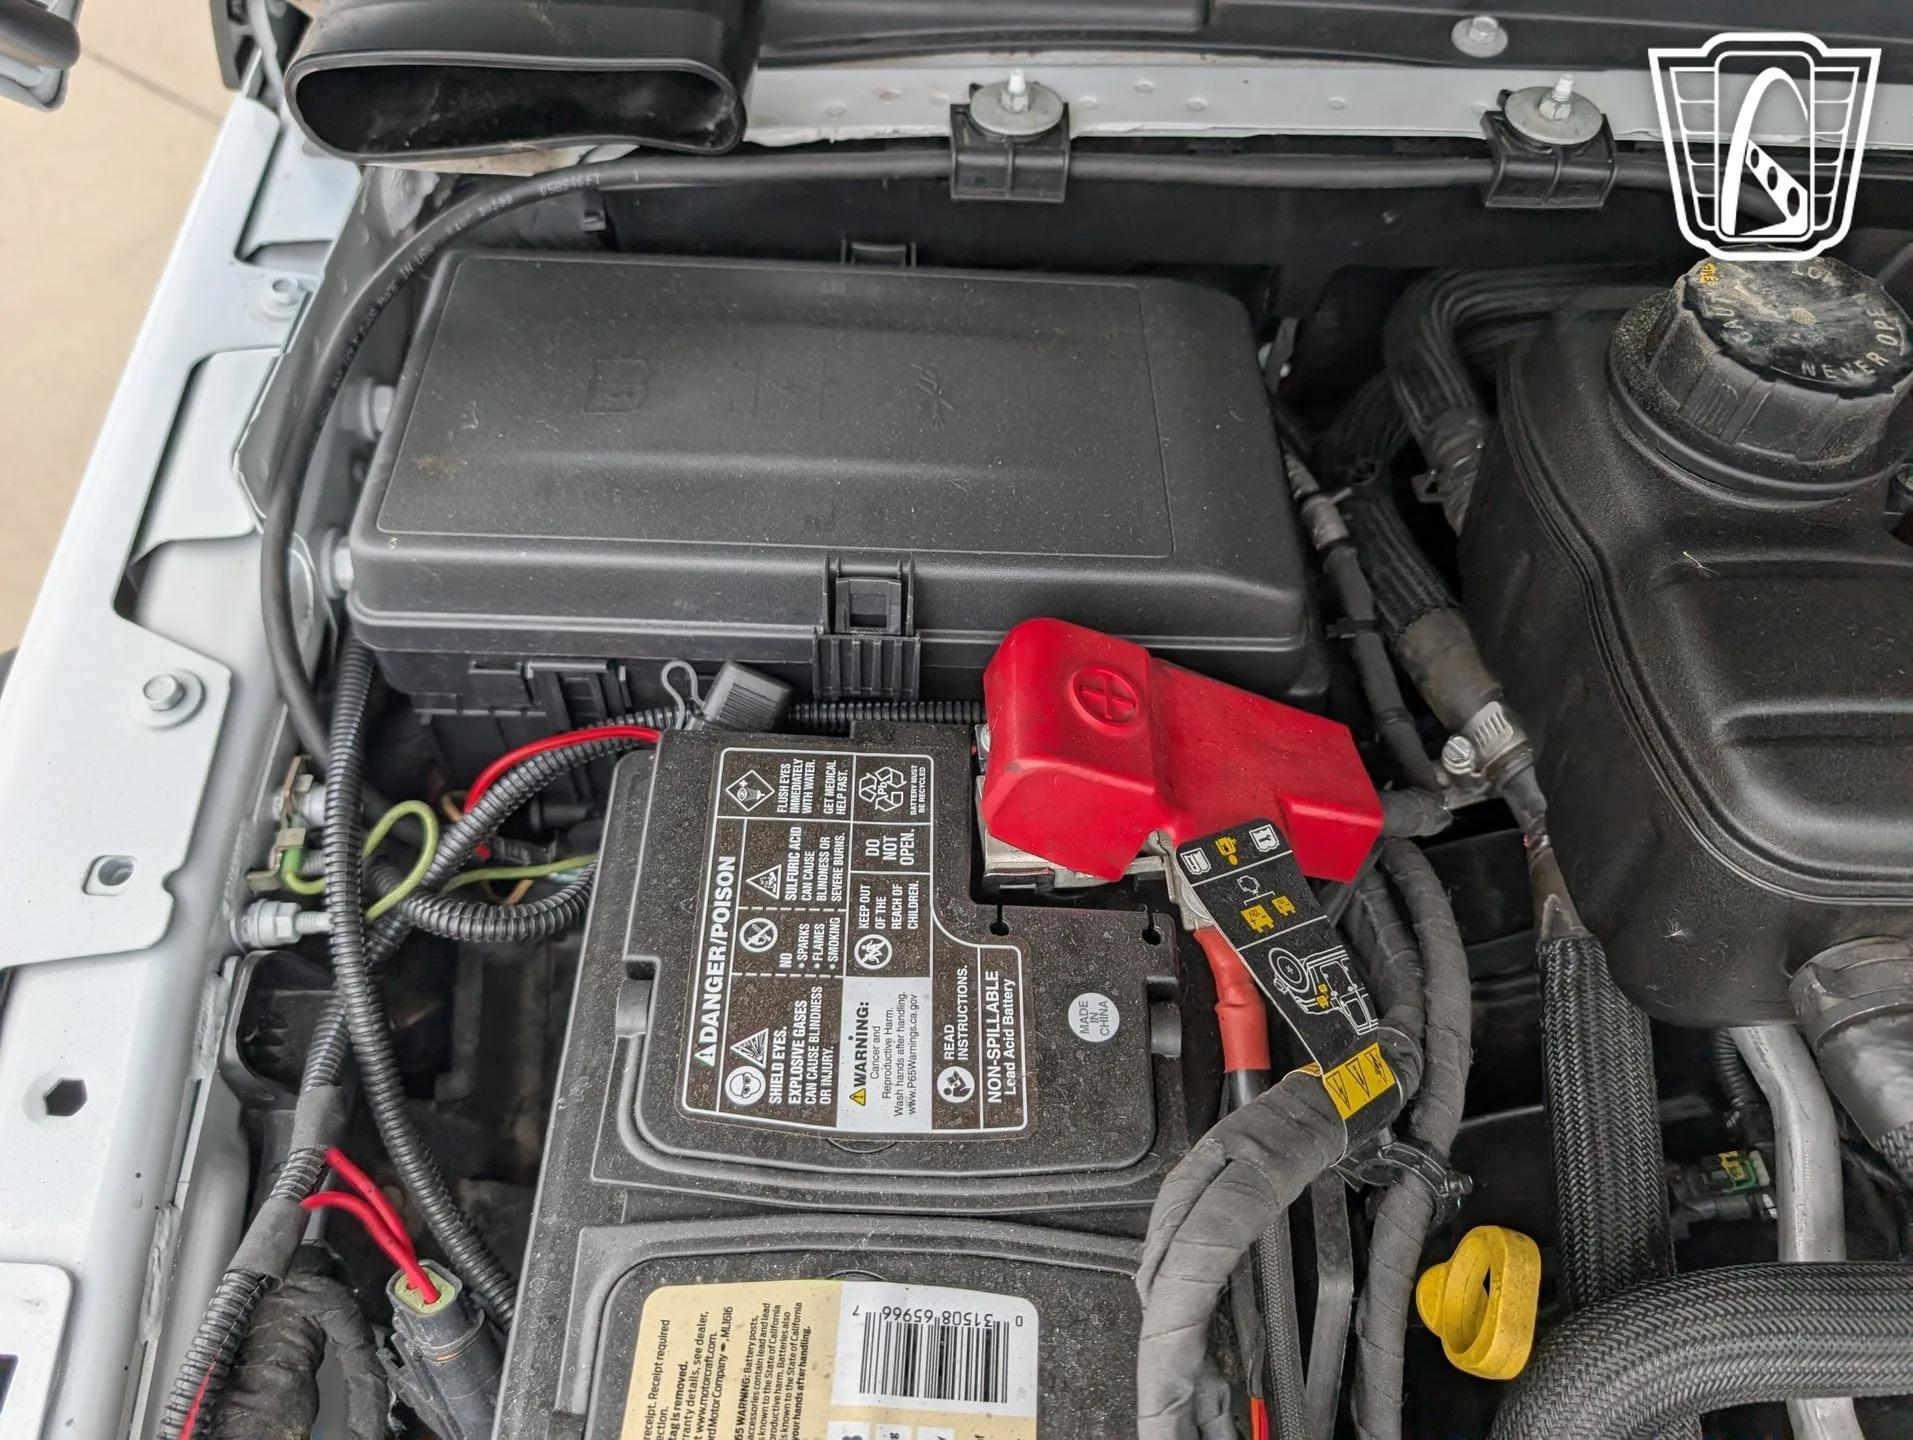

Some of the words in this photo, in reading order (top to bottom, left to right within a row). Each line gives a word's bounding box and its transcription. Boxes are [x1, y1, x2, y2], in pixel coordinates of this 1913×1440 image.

[780, 764, 791, 783] EYES
[790, 758, 803, 813] IMMEDIATELY
[804, 759, 816, 790] WATER.
[825, 760, 836, 796] MEDICAL
[838, 770, 848, 791] FAST.
[878, 782, 887, 794] Pb
[778, 785, 789, 812] FLUSH
[802, 792, 813, 814] WITH
[824, 798, 834, 814] GET
[836, 794, 846, 814] HELP
[919, 804, 925, 813] BE
[789, 826, 802, 850] ACID
[820, 836, 830, 849] OR
[833, 832, 845, 866] BURNS.
[866, 839, 880, 856] DO
[883, 835, 897, 860] NOT
[900, 829, 915, 865] OPEN.
[785, 852, 800, 900] SULFURIC
[802, 851, 815, 880] CAUSE
[816, 852, 829, 901] BLINDNESS
[802, 882, 813, 901] CAN
[832, 868, 843, 901] SEVERE
[860, 884, 870, 903] OUT
[893, 884, 902, 896] OF
[859, 905, 870, 928] KEEP
[876, 896, 886, 914] THE
[892, 899, 902, 929] REACH
[908, 880, 918, 929] CHILDREN.
[876, 916, 886, 929] OF
[699, 856, 736, 1043] DANGER/POISON
[797, 924, 810, 961] SPARKS
[812, 924, 825, 961] FLAMES
[828, 917, 840, 962] SMOKING
[779, 953, 792, 968] NO
[809, 986, 822, 1042] BLINDNESS
[897, 992, 906, 1032] handling.
[958, 965, 968, 1060] INSTRUCTIONS.
[1003, 979, 1014, 1024] Battery
[794, 1000, 808, 1036] GASES
[884, 1008, 893, 1035] Harm.
[1079, 1000, 1090, 1035] MADE
[1089, 1012, 1099, 1024] IN
[1098, 1000, 1110, 1036] CHINA
[772, 1026, 787, 1060] EYES.
[854, 1002, 868, 1088] WARNING:
[872, 1026, 880, 1042] and
[896, 1034, 904, 1054] after
[944, 1024, 954, 1060] READ
[986, 971, 1002, 1102] NON-SPILLABLE
[1003, 1029, 1015, 1058] Acid
[807, 1046, 820, 1080] CAUSE
[822, 1046, 834, 1086] INJURY.
[870, 1046, 880, 1079] Cancer
[882, 1038, 893, 1099] Reproductive
[908, 994, 919, 1114] www.P65Warnings.ca.gov
[769, 1063, 784, 1104] SHIELD
[788, 1040, 805, 1104] EXPLOSIVE
[895, 1058, 904, 1086] hands
[1005, 1062, 1016, 1094] Lead
[805, 1083, 817, 1104] CAN
[820, 1090, 832, 1104] OR
[894, 1090, 904, 1116] Wash
[852, 1305, 860, 1316] 7
[882, 1306, 933, 1324] 65966
[942, 1310, 994, 1328] 31508
